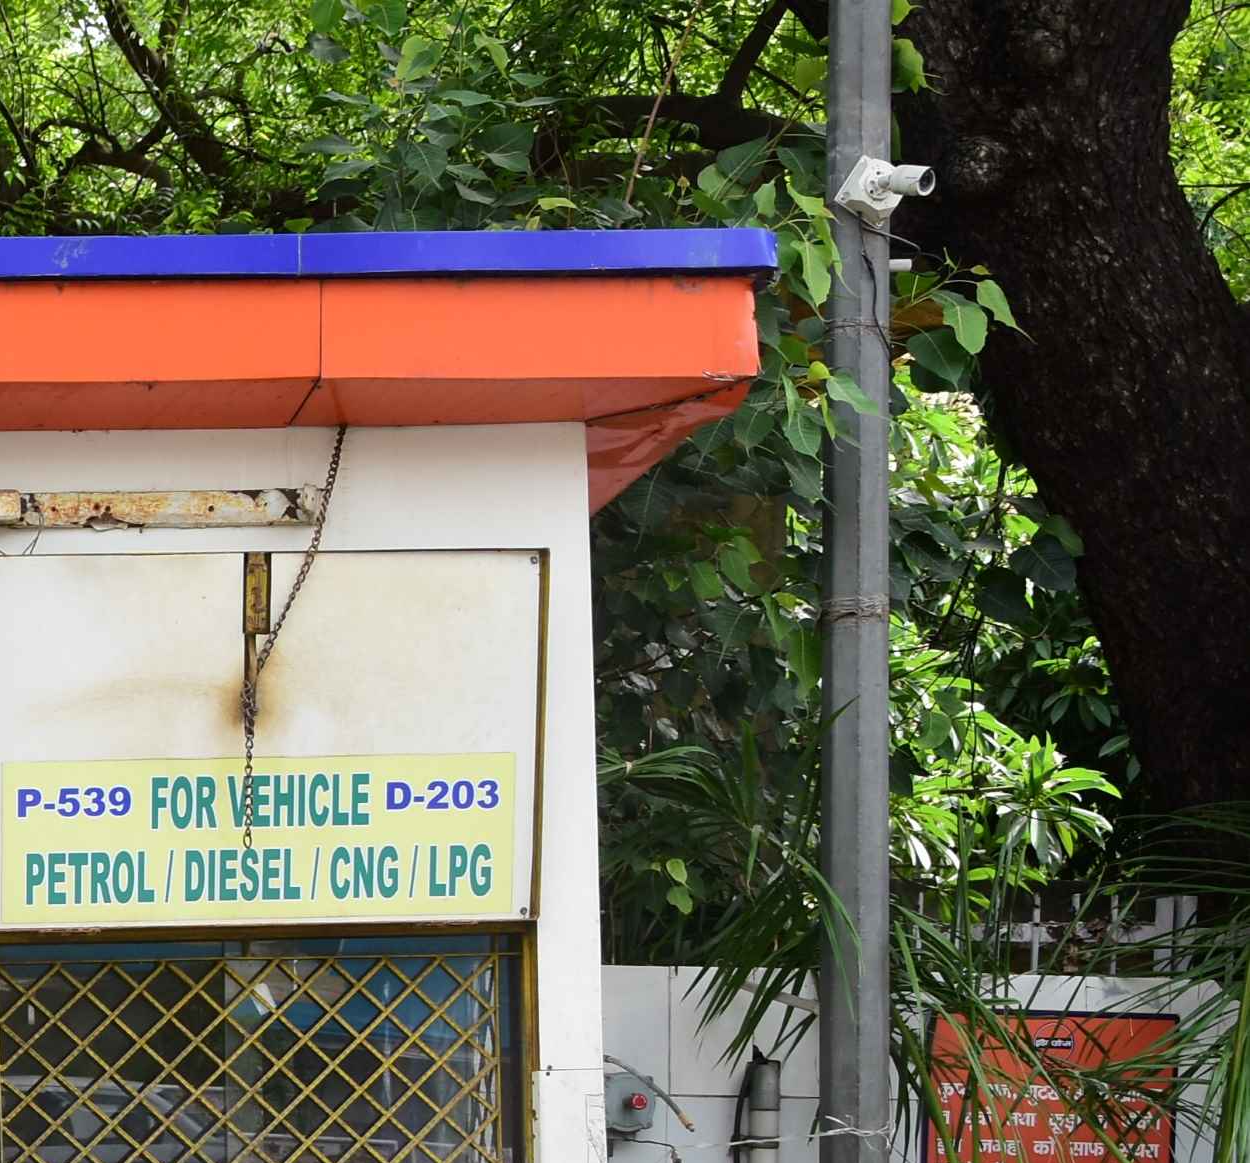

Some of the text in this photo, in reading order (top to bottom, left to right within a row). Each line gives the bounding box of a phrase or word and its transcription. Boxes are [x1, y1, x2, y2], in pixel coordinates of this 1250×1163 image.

[18, 773, 499, 829] P-539 FOR VEHICLE D-203
[26, 851, 154, 905] PETROL
[185, 848, 300, 901] DIESEL
[330, 846, 398, 899] CNG
[429, 844, 492, 896] LPG
